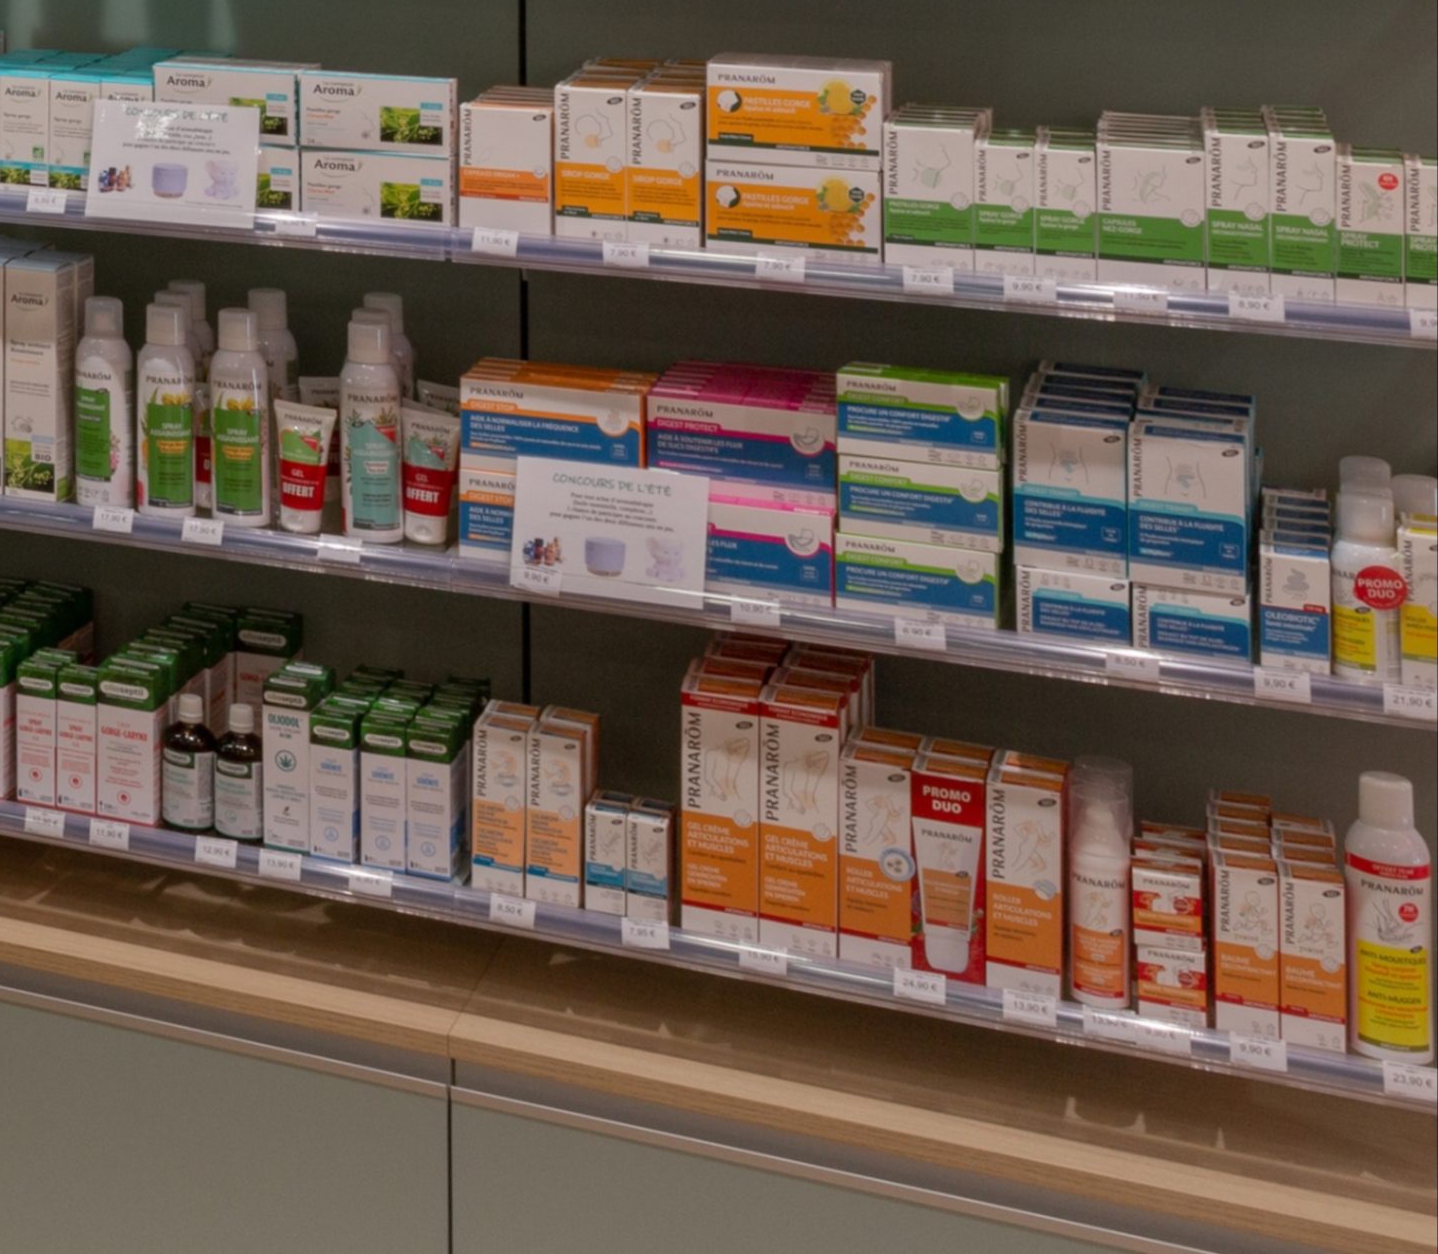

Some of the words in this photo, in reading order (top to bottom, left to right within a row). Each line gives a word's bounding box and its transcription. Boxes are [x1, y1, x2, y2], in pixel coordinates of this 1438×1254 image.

[166, 75, 206, 89] Aroma
[312, 83, 356, 98] Aroma
[743, 96, 782, 107] PASTILLES
[783, 98, 811, 109] GORGE
[314, 158, 356, 173] Aroma
[561, 169, 583, 179] SIROP
[584, 171, 611, 181] GORGE
[632, 175, 655, 185] SIROP
[657, 177, 683, 186] GORGE
[742, 193, 781, 203] PASTILLES
[782, 194, 809, 206] GORGE
[1276, 225, 1298, 235] SPRAY
[1299, 227, 1328, 237] NASAL
[1341, 231, 1367, 240] SPRAY
[1341, 238, 1380, 248] PROTECT
[656, 418, 684, 428] DIGEST
[685, 421, 720, 433] PROTECT
[290, 468, 305, 478] GEL
[552, 472, 614, 489] CONCOURS
[617, 479, 635, 492] DE
[281, 483, 315, 498] OFFERT
[405, 487, 440, 503] OFFERT
[1357, 576, 1404, 591] PROMO
[1367, 587, 1397, 599] DUO
[1392, 694, 1421, 707] 21,90
[1423, 696, 1433, 708] €
[922, 783, 972, 803] PROMO
[932, 799, 963, 815] DUO
[687, 830, 749, 848] ARTICULATIONS
[765, 834, 782, 845] GEL
[687, 839, 697, 848] ET
[698, 841, 735, 855] MUSCLES
[765, 843, 828, 862] ARTICULATIONS
[765, 851, 776, 860] ET
[776, 853, 813, 869] MUSCLES
[846, 866, 873, 878] ROLLER
[846, 875, 903, 893] ARTICULATIONS
[993, 893, 1022, 905] ROLLER
[993, 902, 1052, 921] ARTICULATIONS
[993, 911, 1003, 920] ET
[1004, 913, 1038, 927] MUSCLES
[1221, 954, 1250, 965] BAUME
[1285, 965, 1315, 977] BAUME
[928, 981, 938, 992] €
[1393, 1073, 1421, 1086] 23,90
[1422, 1075, 1432, 1087] €
